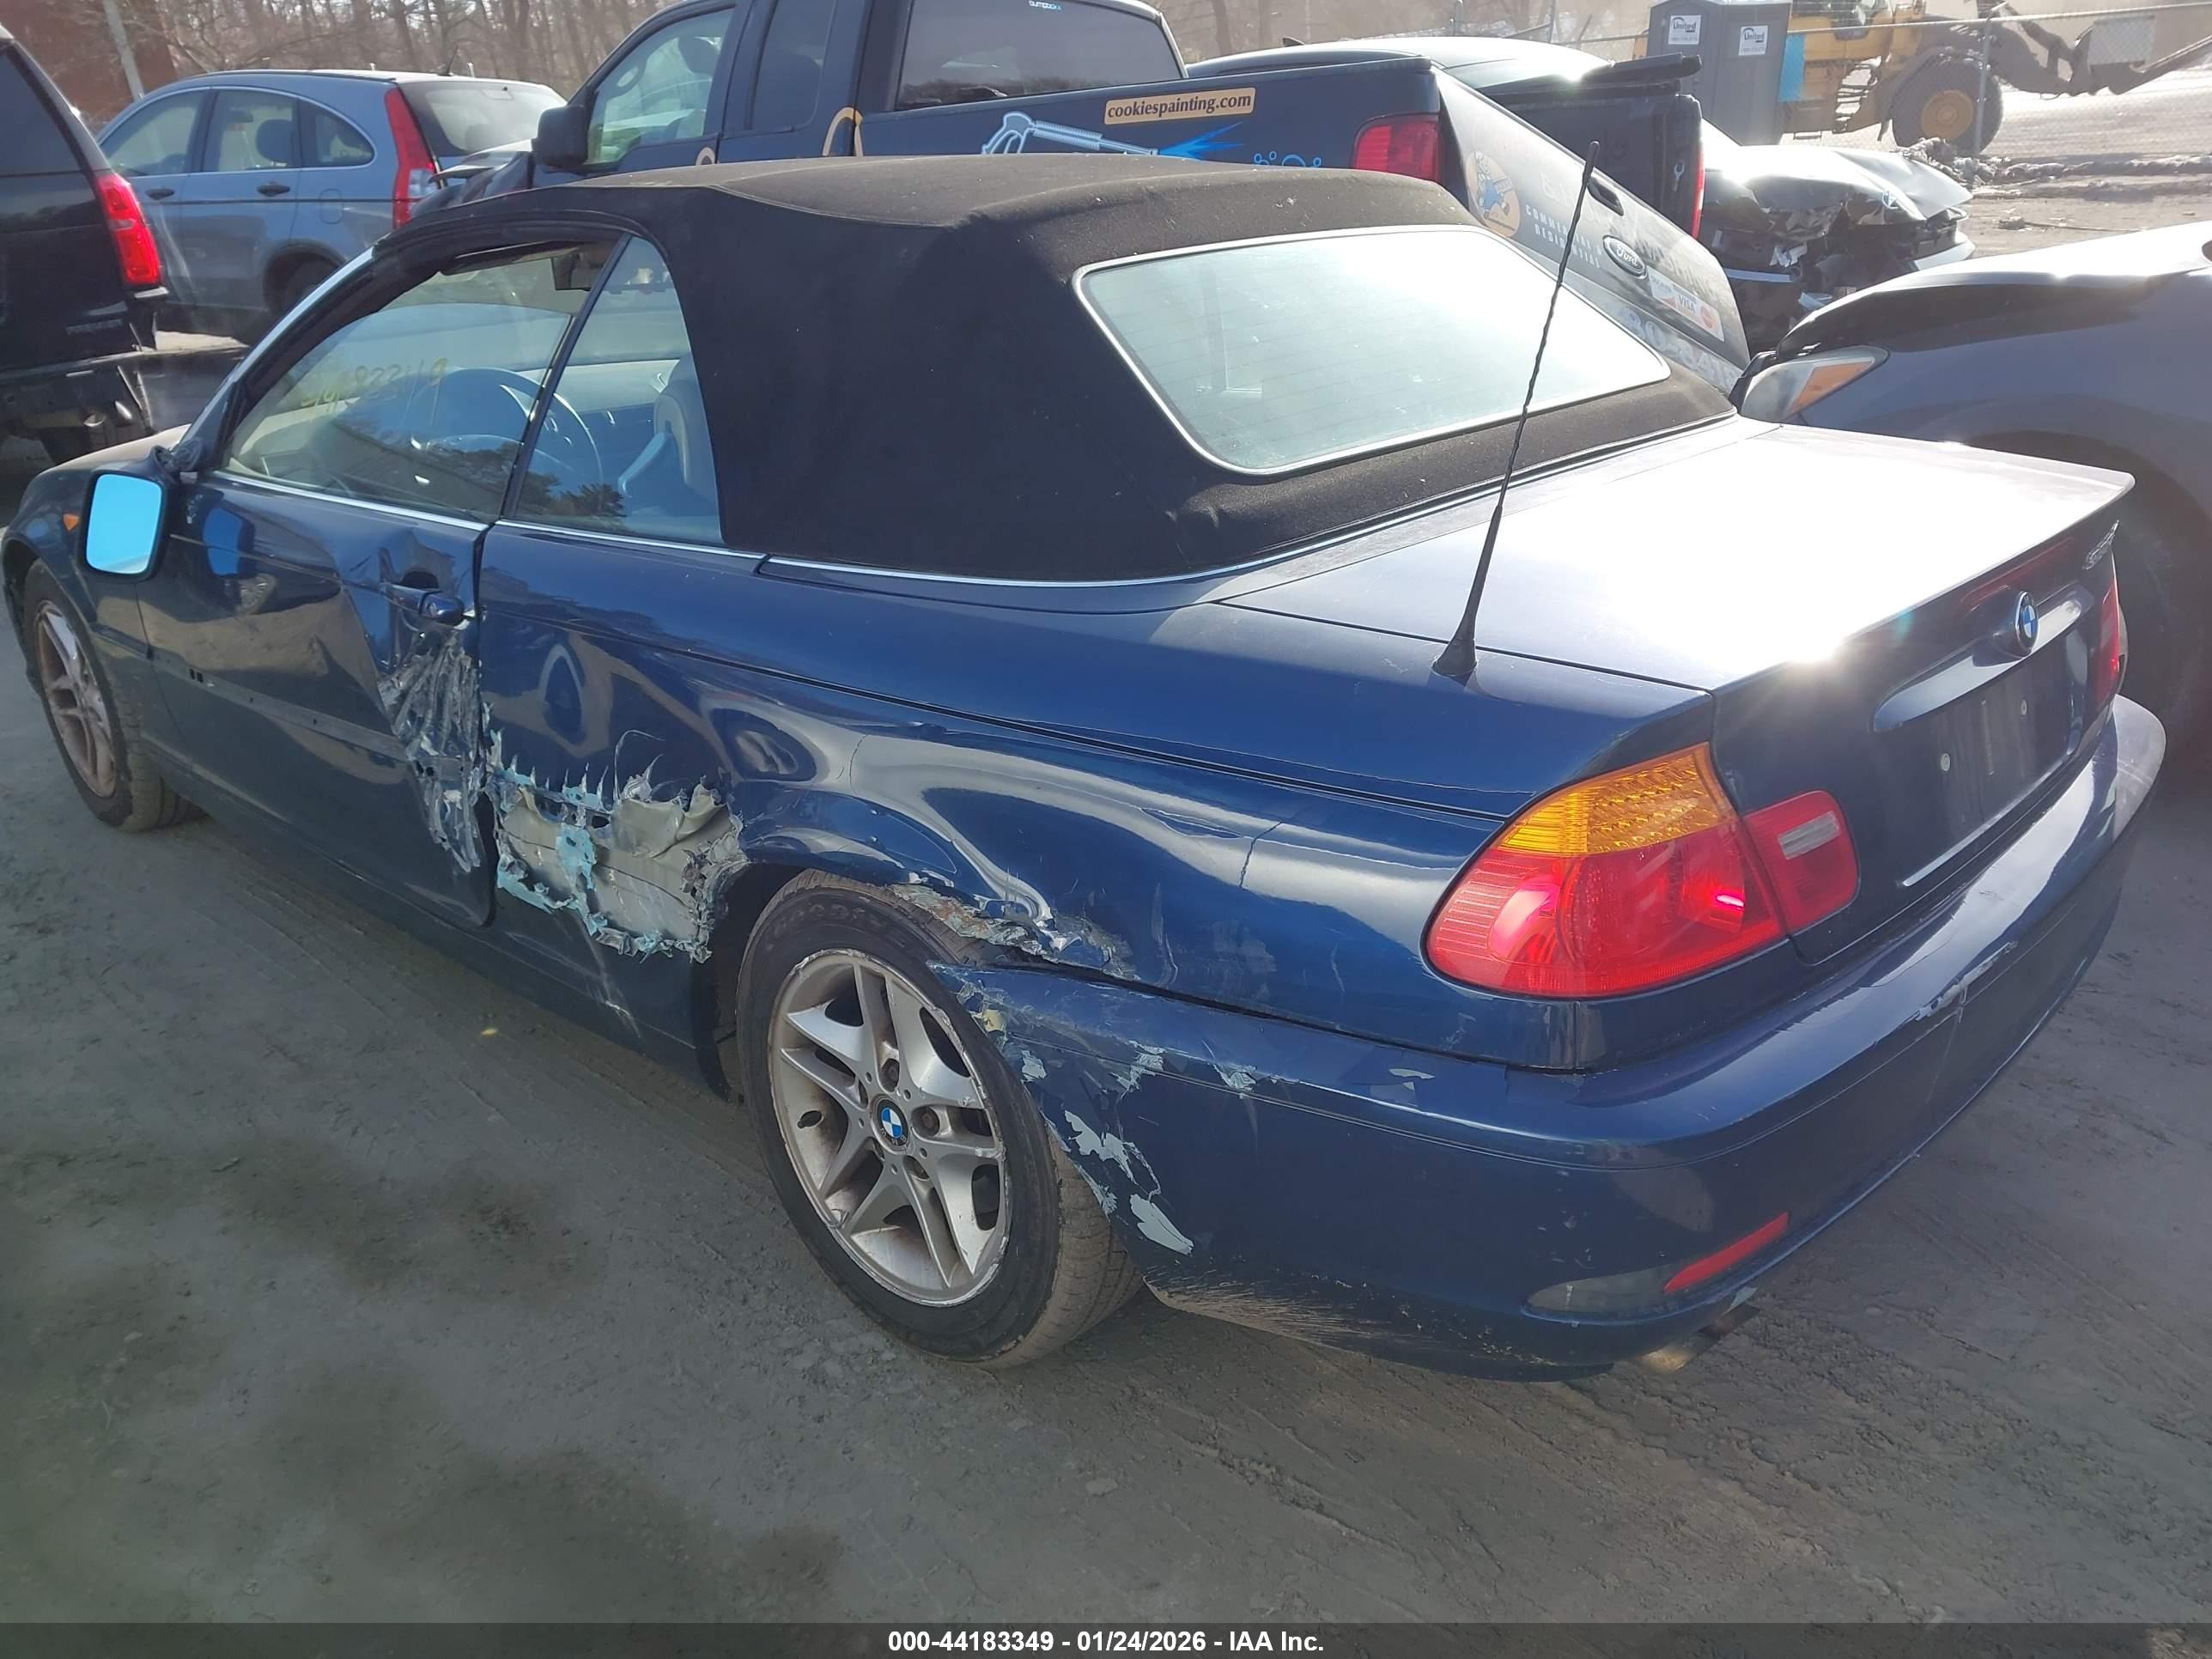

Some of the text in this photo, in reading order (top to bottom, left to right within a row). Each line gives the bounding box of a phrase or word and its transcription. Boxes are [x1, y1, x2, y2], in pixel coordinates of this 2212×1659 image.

[1108, 95, 1251, 118] cookiespainting.com
[1534, 223, 1600, 268] RESIDNTIAL
[1617, 244, 1638, 266] Ford
[1678, 294, 1697, 313] VISA
